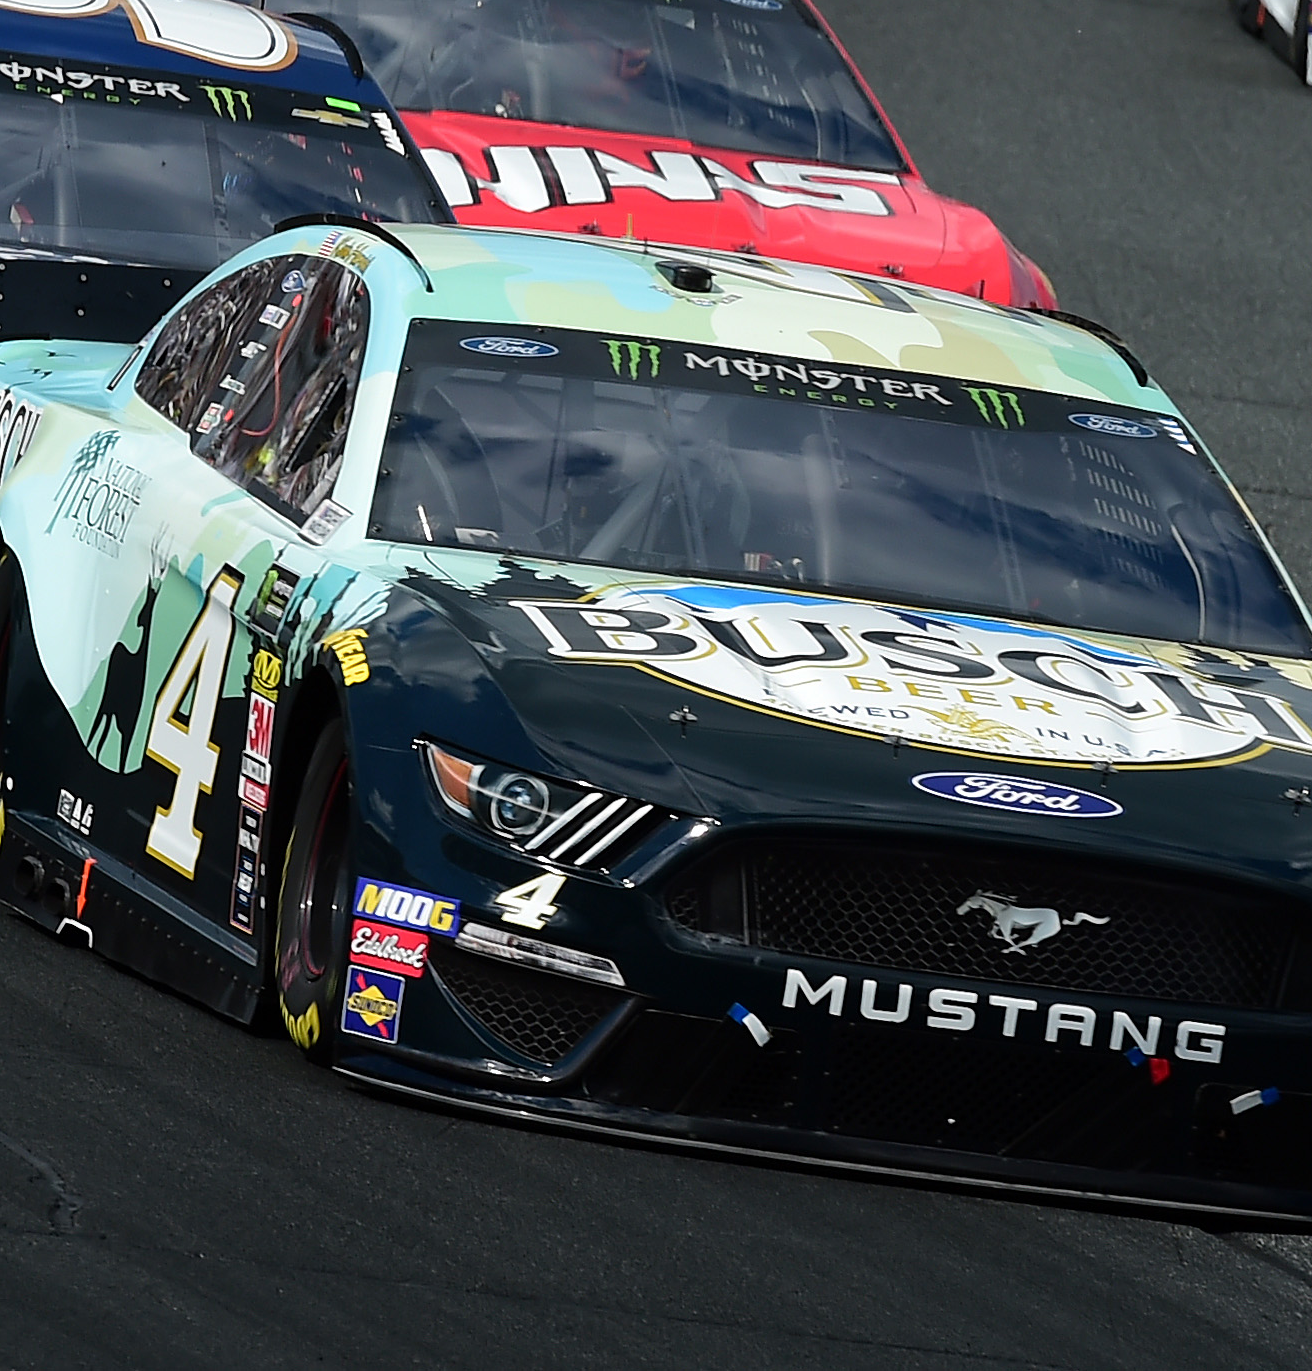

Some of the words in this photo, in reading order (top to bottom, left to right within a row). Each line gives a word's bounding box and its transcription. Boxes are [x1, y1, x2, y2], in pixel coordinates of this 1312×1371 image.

[14, 83, 141, 107] ENERGY
[683, 349, 954, 408] MONSTER
[753, 383, 900, 411] ENERGY
[846, 673, 1061, 718] BEER
[145, 568, 245, 881] 4
[1035, 726, 1070, 743] IN
[949, 771, 1087, 813] Ford
[356, 883, 456, 932] MOOG
[493, 871, 568, 931] 4
[351, 926, 427, 968] Edelbrock
[782, 968, 1227, 1064] MUSTANG
